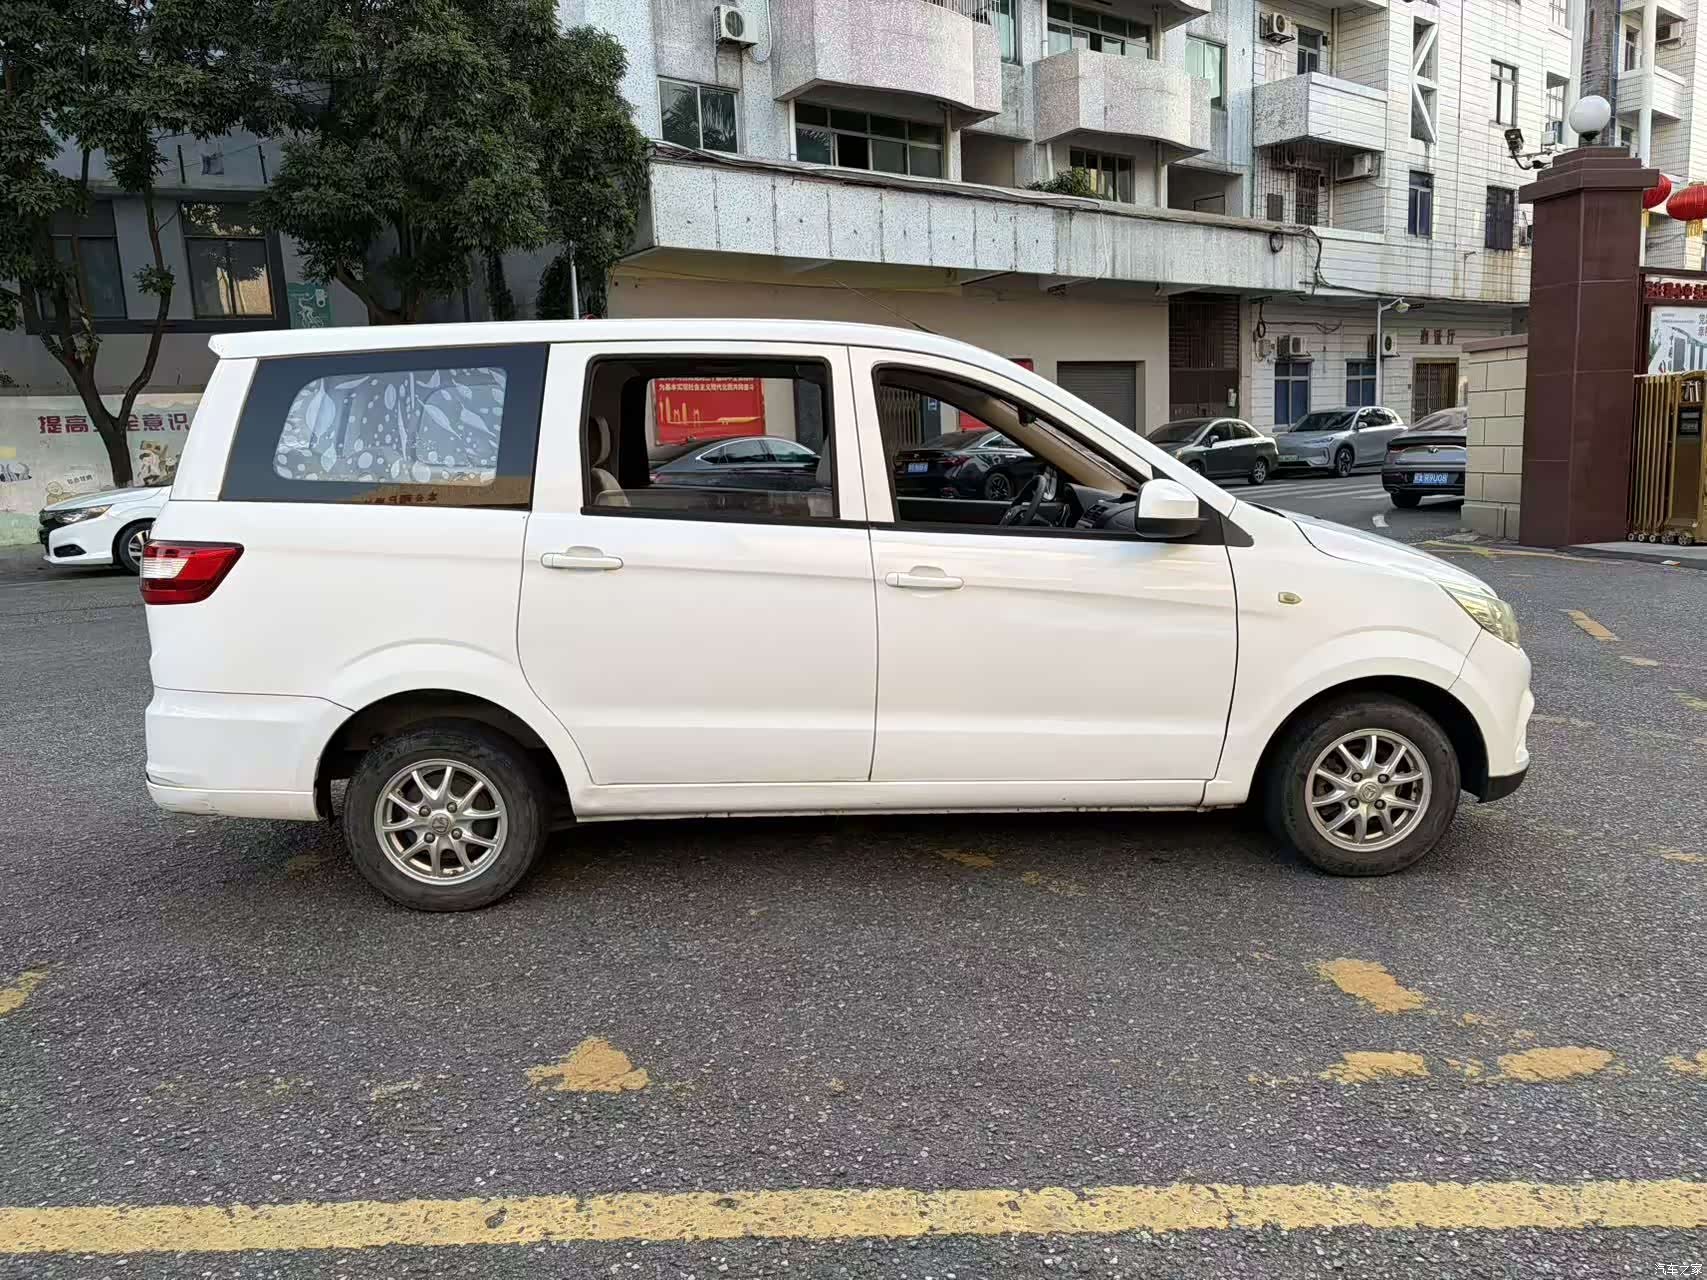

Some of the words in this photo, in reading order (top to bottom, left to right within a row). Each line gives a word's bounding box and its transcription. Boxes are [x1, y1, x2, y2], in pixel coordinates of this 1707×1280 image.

[38, 413, 190, 434] 提高全意识
